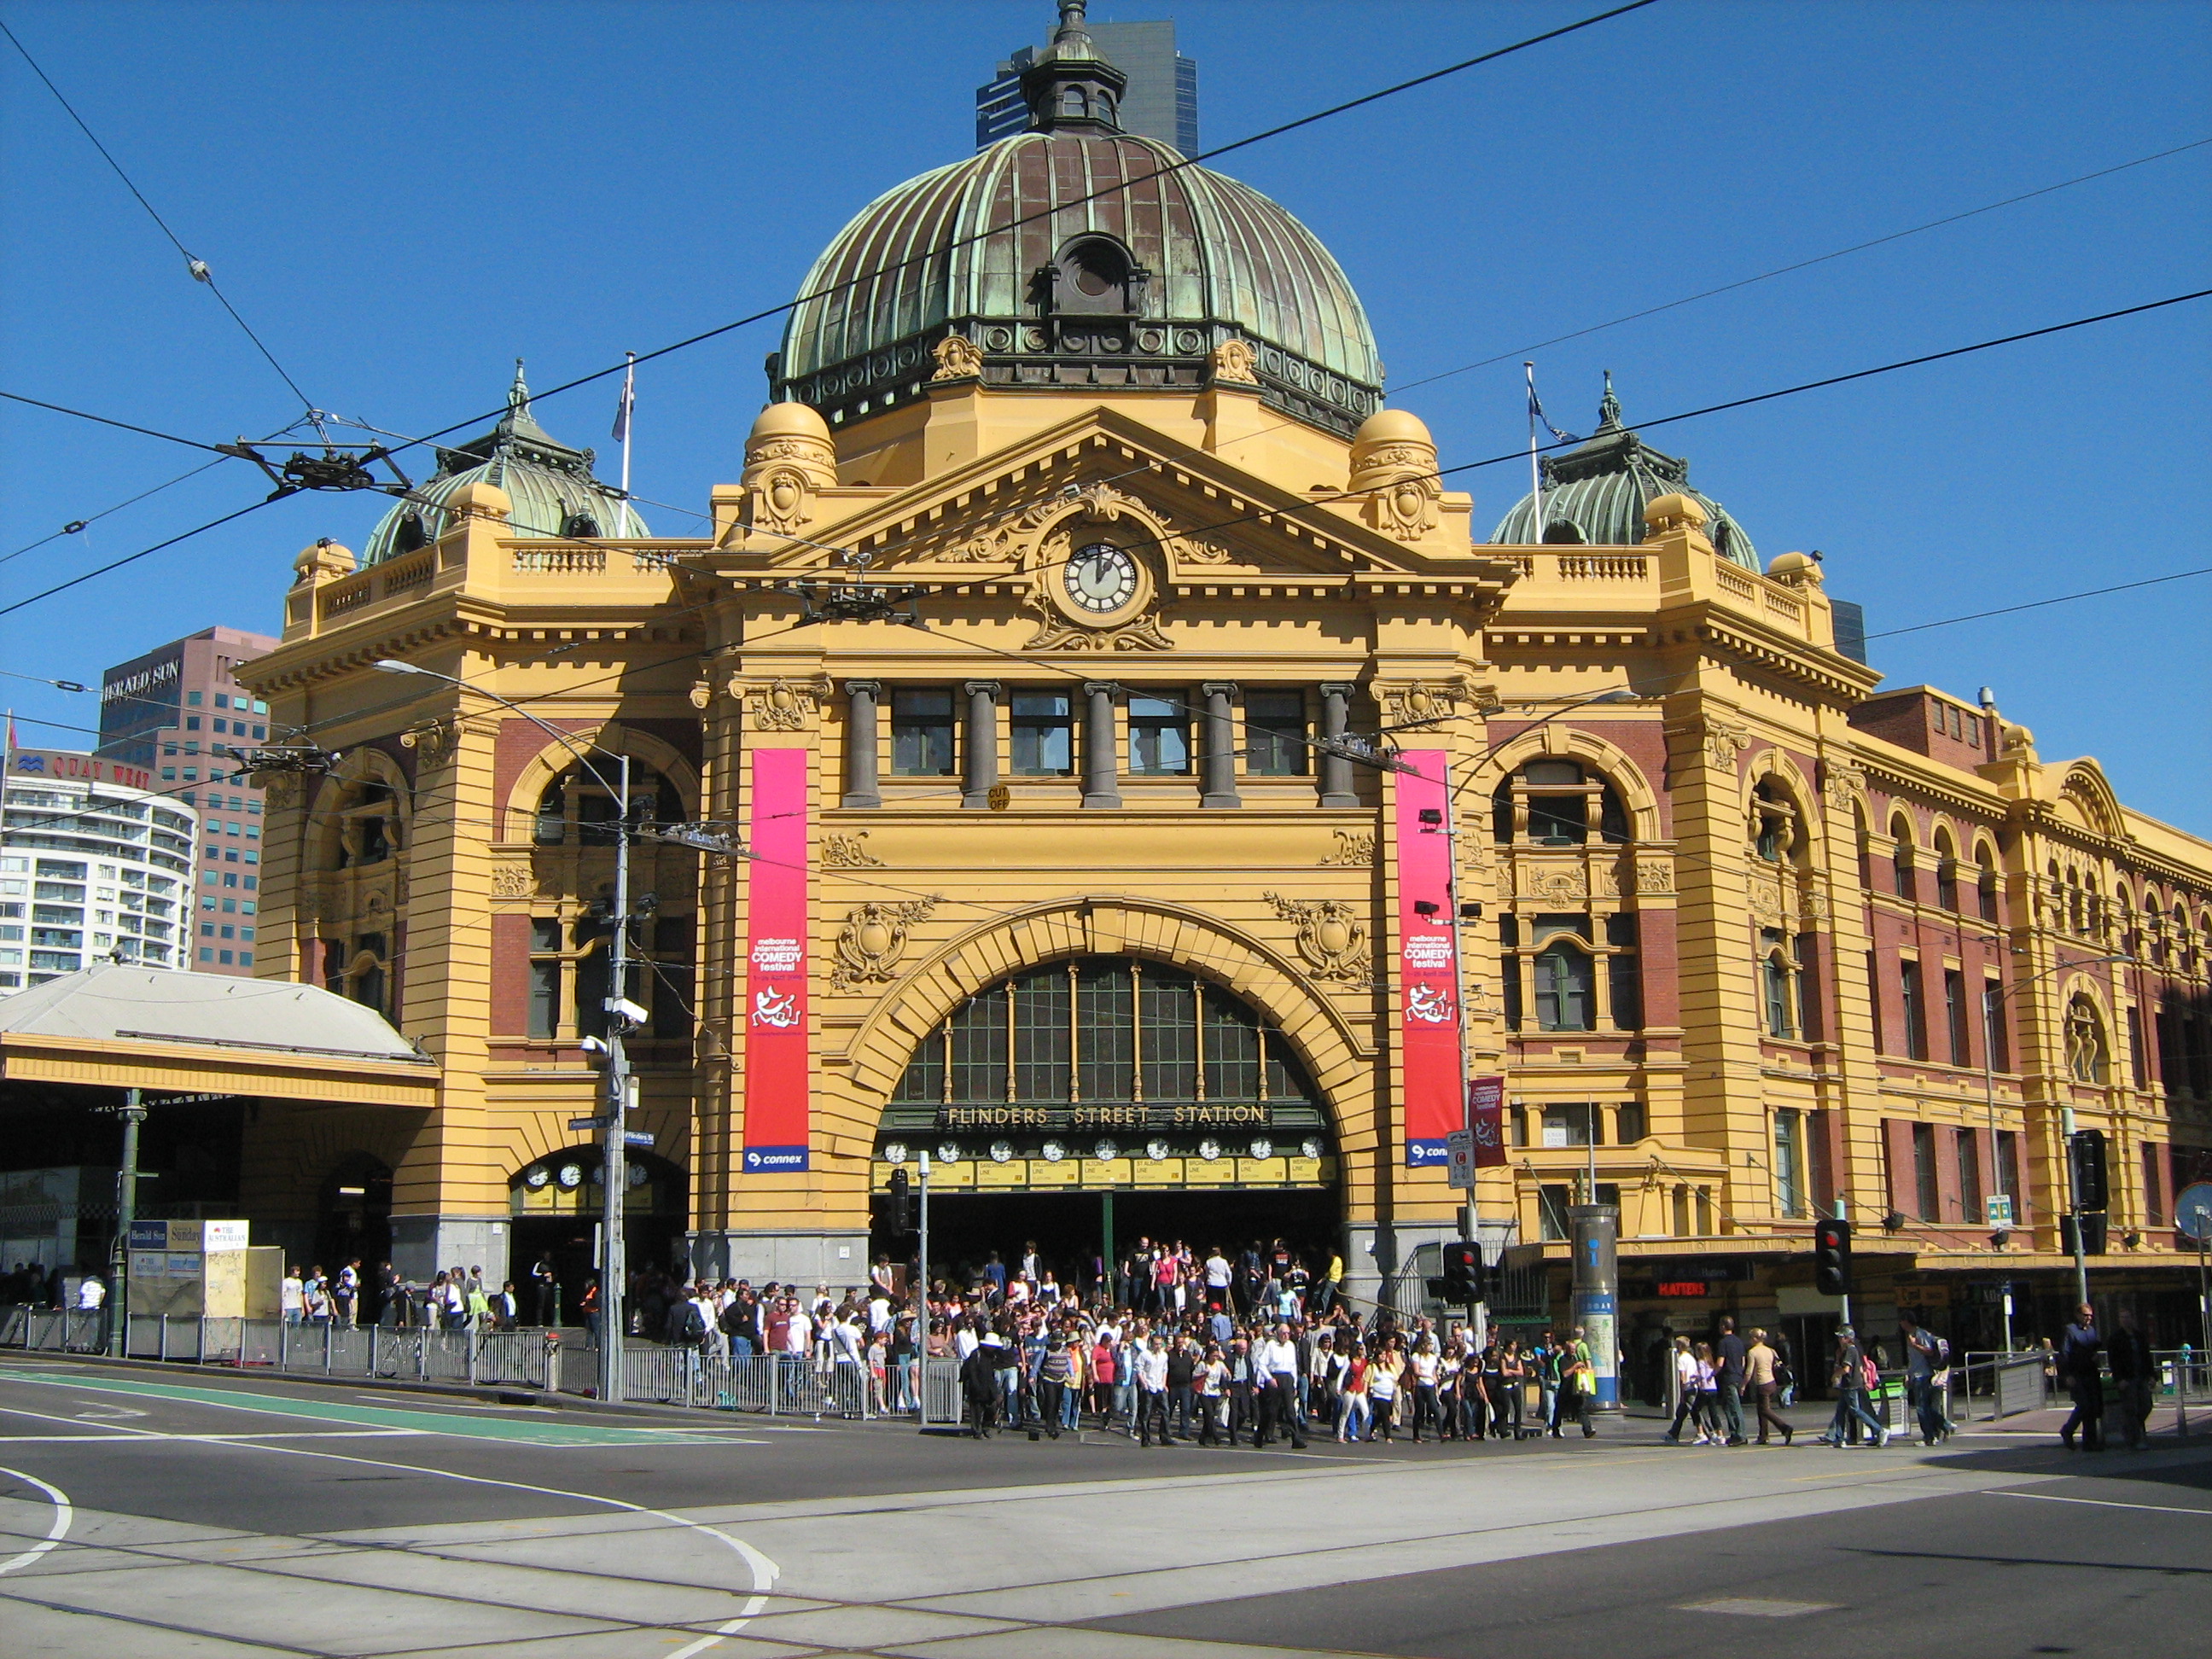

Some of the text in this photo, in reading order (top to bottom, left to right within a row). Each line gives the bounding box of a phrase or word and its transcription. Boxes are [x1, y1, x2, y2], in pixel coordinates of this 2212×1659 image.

[100, 660, 178, 704] HERALD SUN
[53, 756, 150, 790] QUAY WEST
[989, 787, 1006, 798] CUT
[990, 800, 1008, 810] OFF
[751, 952, 803, 963] COMEDY
[1404, 948, 1452, 959] COMEDY
[760, 962, 795, 971] festival
[1412, 958, 1447, 968] festival
[1472, 1094, 1500, 1104] COMEDY
[948, 1105, 1265, 1124] FLINDERS STREET STATION
[1426, 1148, 1448, 1156] con
[763, 1155, 802, 1165] connex
[131, 1230, 166, 1241] Herald Sun
[172, 1226, 201, 1245] Sunday
[207, 1234, 246, 1243] AUSTRALIAN
[1657, 1282, 1706, 1296] HATTERS
